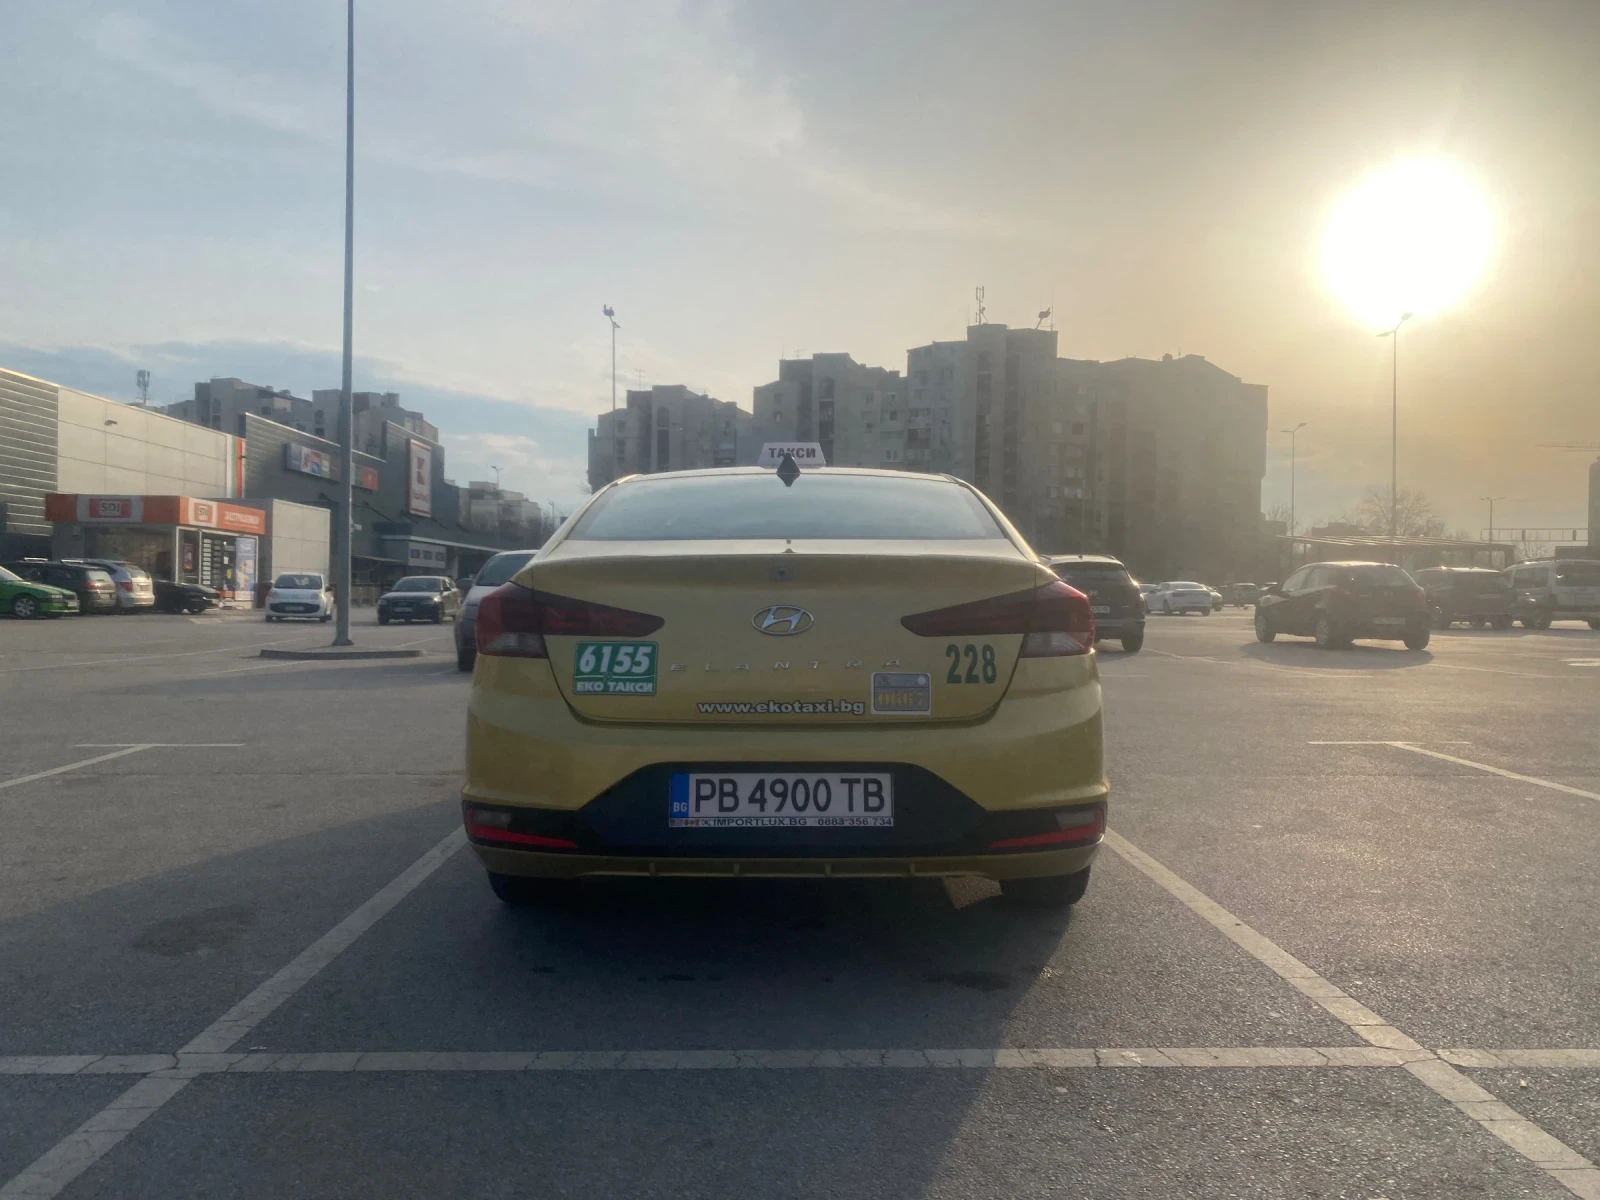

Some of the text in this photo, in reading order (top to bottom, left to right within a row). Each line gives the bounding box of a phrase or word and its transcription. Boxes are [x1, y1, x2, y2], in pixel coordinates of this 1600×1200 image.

[768, 447, 816, 459] ТАКСИ
[100, 502, 120, 513] SDI
[579, 645, 653, 674] 6155
[669, 658, 901, 672] ELANTRA
[945, 644, 997, 685] 228
[575, 681, 654, 694] ЕКО ТАКСИ
[697, 699, 865, 716] www.ekotaxi.bg
[694, 778, 885, 813] PB 4900 TB
[673, 802, 688, 813] BG
[713, 818, 807, 827] IMPORTLUX.BG
